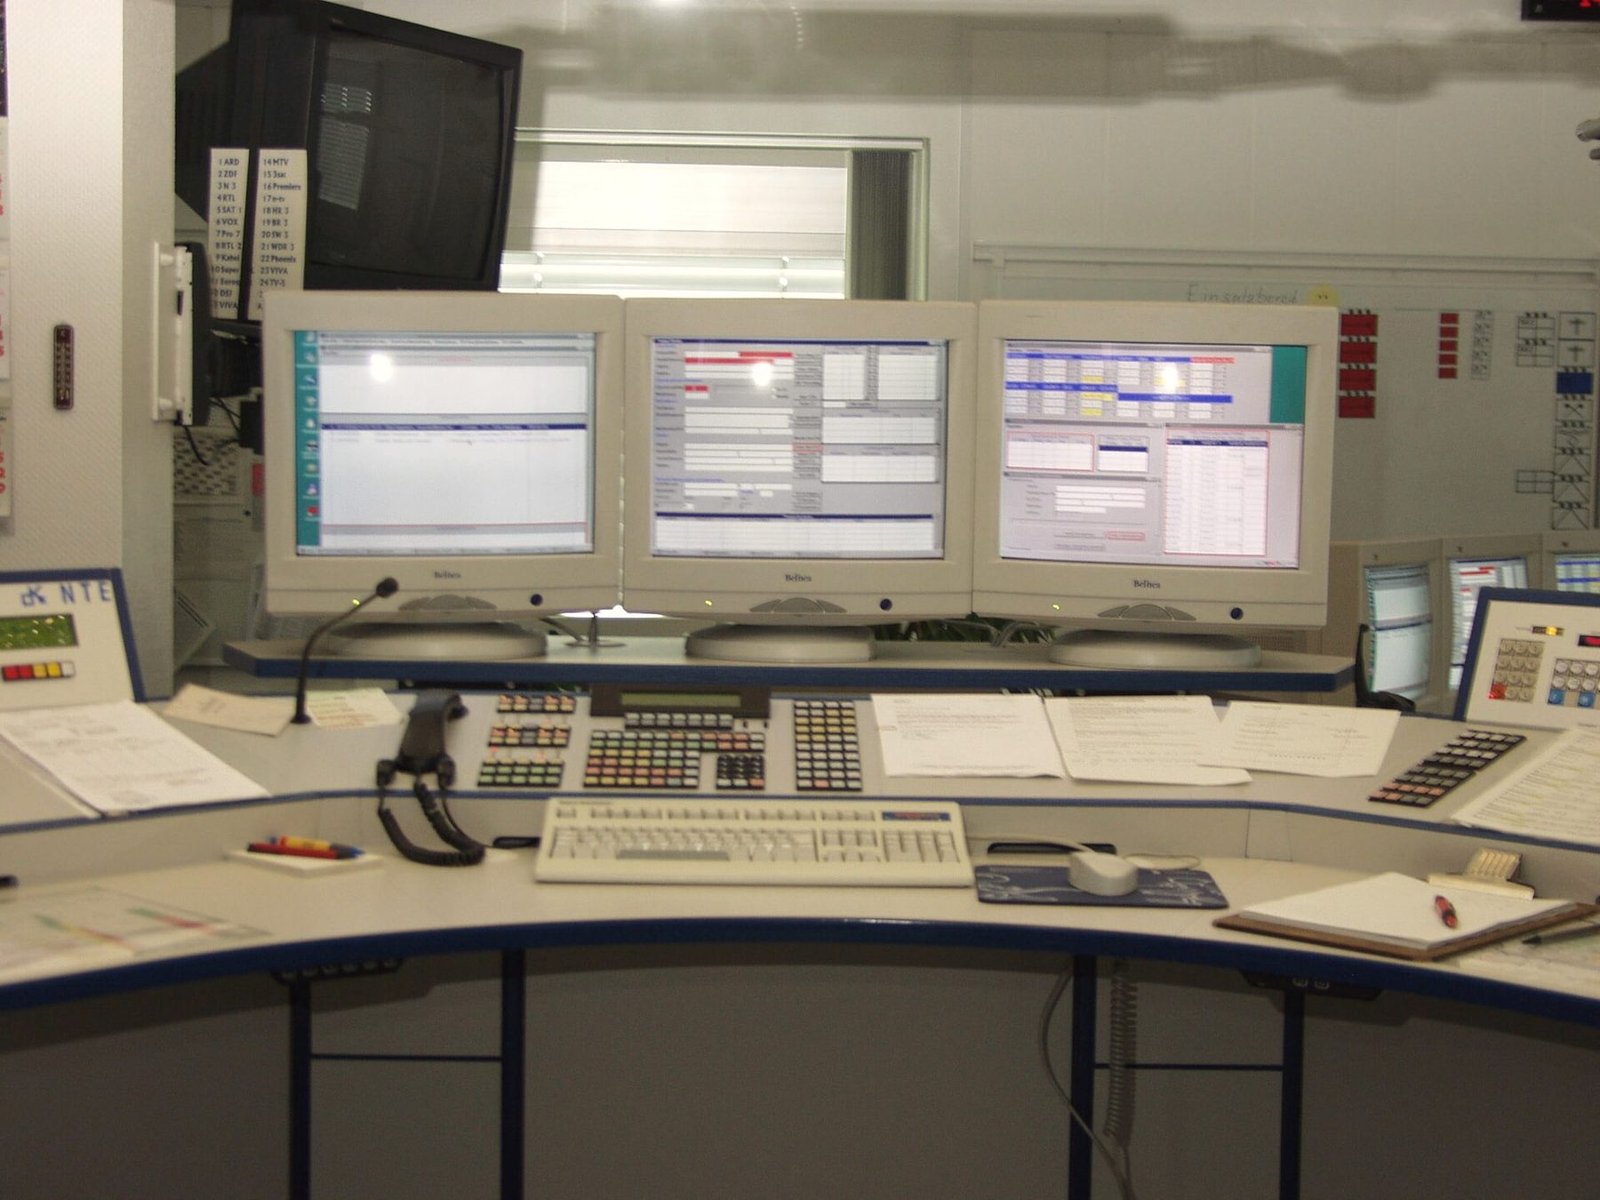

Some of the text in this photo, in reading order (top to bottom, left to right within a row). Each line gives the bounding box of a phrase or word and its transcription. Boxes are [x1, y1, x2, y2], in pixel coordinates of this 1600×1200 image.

[223, 158, 240, 166] ARD
[273, 158, 288, 166] MTV
[223, 170, 237, 178] ZDF
[223, 194, 236, 202] RTL
[271, 242, 287, 250] WDR
[270, 267, 289, 275] VIVA
[219, 301, 239, 309] VIVA
